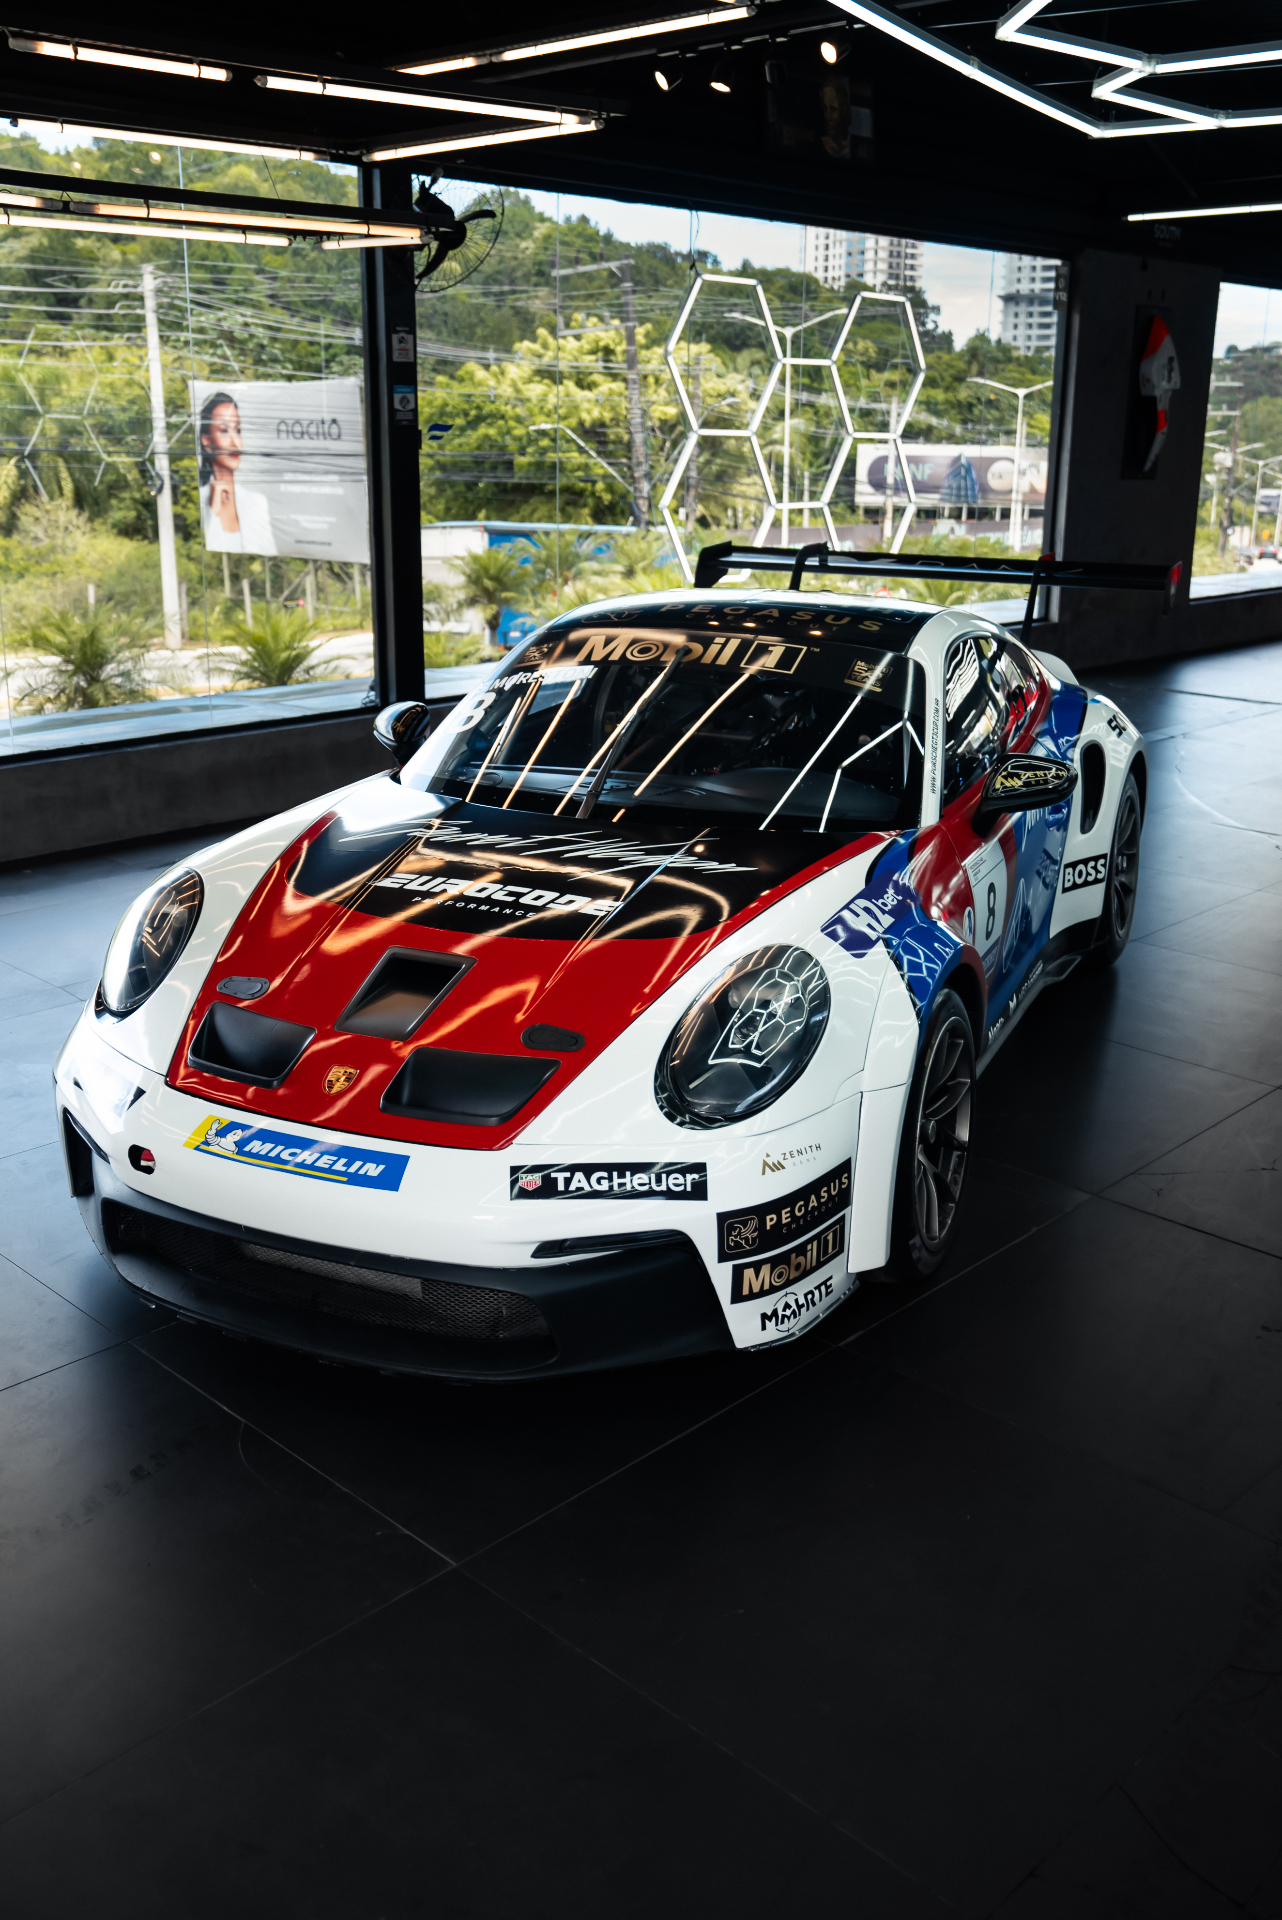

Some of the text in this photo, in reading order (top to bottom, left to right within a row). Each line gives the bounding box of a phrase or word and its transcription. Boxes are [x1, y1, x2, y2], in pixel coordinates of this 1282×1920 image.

[1153, 223, 1182, 241] SOUTH
[659, 604, 884, 631] PEGASUS
[685, 613, 840, 632] CHECKOUT
[573, 635, 742, 666] Mobil
[1019, 770, 1066, 779] ZENITH
[1064, 858, 1106, 889] BOSS
[370, 873, 624, 917] EUROCODE
[411, 896, 537, 919] PERFORMANCE
[985, 882, 997, 941] 8
[243, 1139, 386, 1177] MICHELIN
[781, 1143, 822, 1161] ZENITH
[765, 1173, 849, 1230] PEGASUS
[782, 1197, 839, 1234] CHECKOUT
[742, 1240, 818, 1296] Mobil
